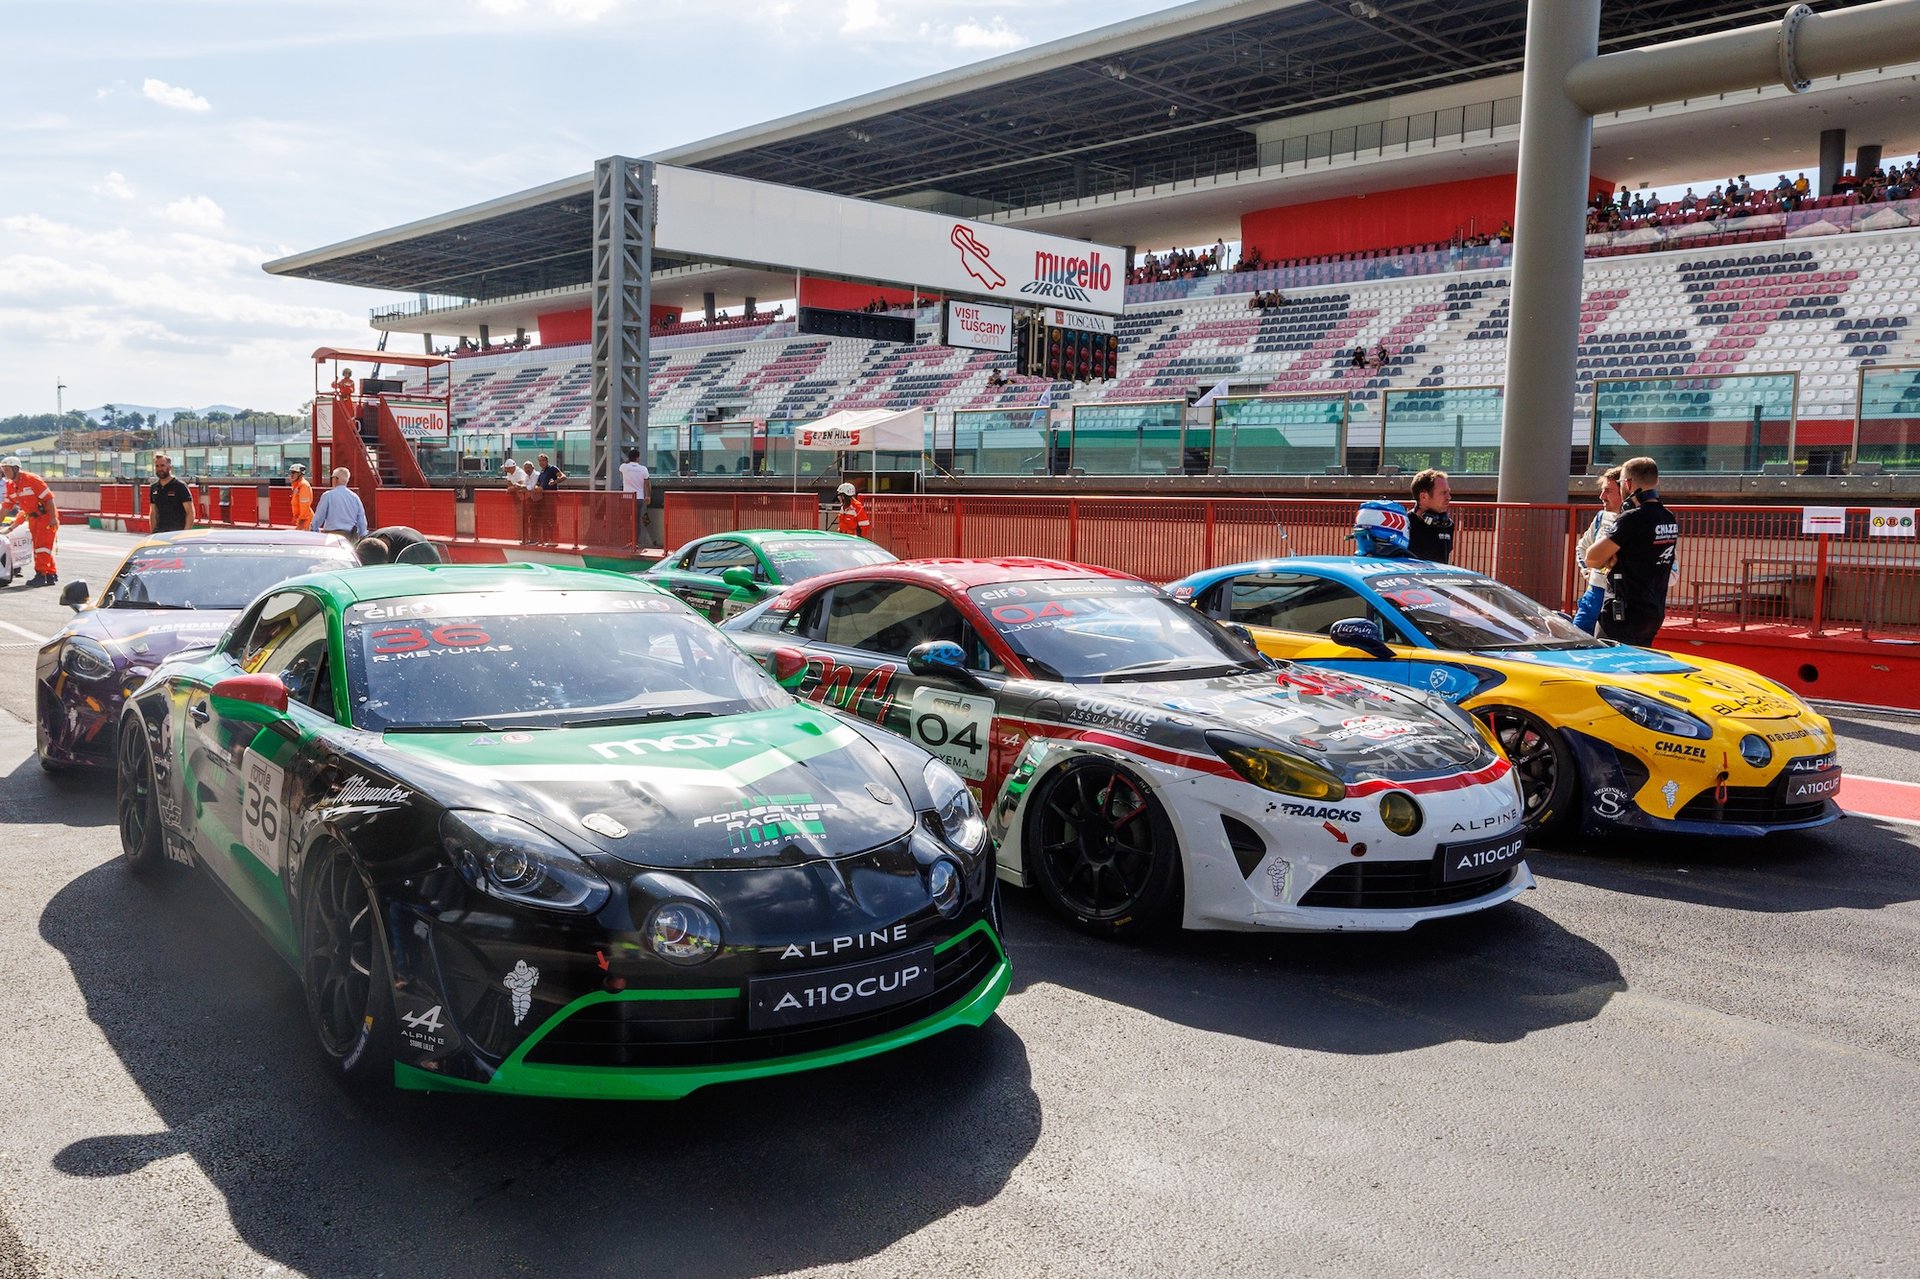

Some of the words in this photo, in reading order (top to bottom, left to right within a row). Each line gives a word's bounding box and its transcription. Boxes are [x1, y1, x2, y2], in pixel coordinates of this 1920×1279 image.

[1034, 250, 1111, 293] mugello
[1020, 280, 1092, 304] CIRCUIT
[1066, 313, 1106, 331] TOSCANA
[971, 333, 1000, 345] .com
[396, 413, 444, 431] mugello
[1654, 523, 1678, 535] CHAZE
[1060, 585, 1118, 593] MICHELIN
[1124, 585, 1146, 594] elf
[1175, 587, 1192, 596] PRO
[1375, 577, 1397, 588] elf
[775, 599, 792, 609] PRO
[982, 589, 1008, 601] elf
[1381, 589, 1434, 608] 10
[364, 603, 409, 620] elf
[612, 600, 647, 610] elf
[991, 601, 1074, 624] 04
[371, 624, 493, 654] 36
[372, 644, 514, 663] R.MEYUHAS
[1069, 710, 1150, 735] ASSURANCES
[917, 713, 982, 755] 04
[588, 733, 754, 759] max
[1655, 741, 1707, 758] CHAZEL
[939, 753, 969, 769] YEMA
[1792, 755, 1837, 771] ALPIN
[332, 773, 410, 805] Milwaukee
[246, 781, 278, 842] 36
[693, 803, 838, 828] FORESTIER
[1280, 803, 1361, 822] TRAACKS
[1450, 808, 1518, 833] ALPINE
[726, 812, 820, 832] RACING
[732, 846, 748, 854] BY
[755, 840, 779, 850] VPS
[785, 833, 827, 842] RACING
[1457, 839, 1522, 870] A110CUP
[780, 924, 907, 960] ALPINE
[773, 966, 919, 1012] A110CUP
[401, 1030, 445, 1045] ALPINE
[409, 1038, 423, 1049] STORE
